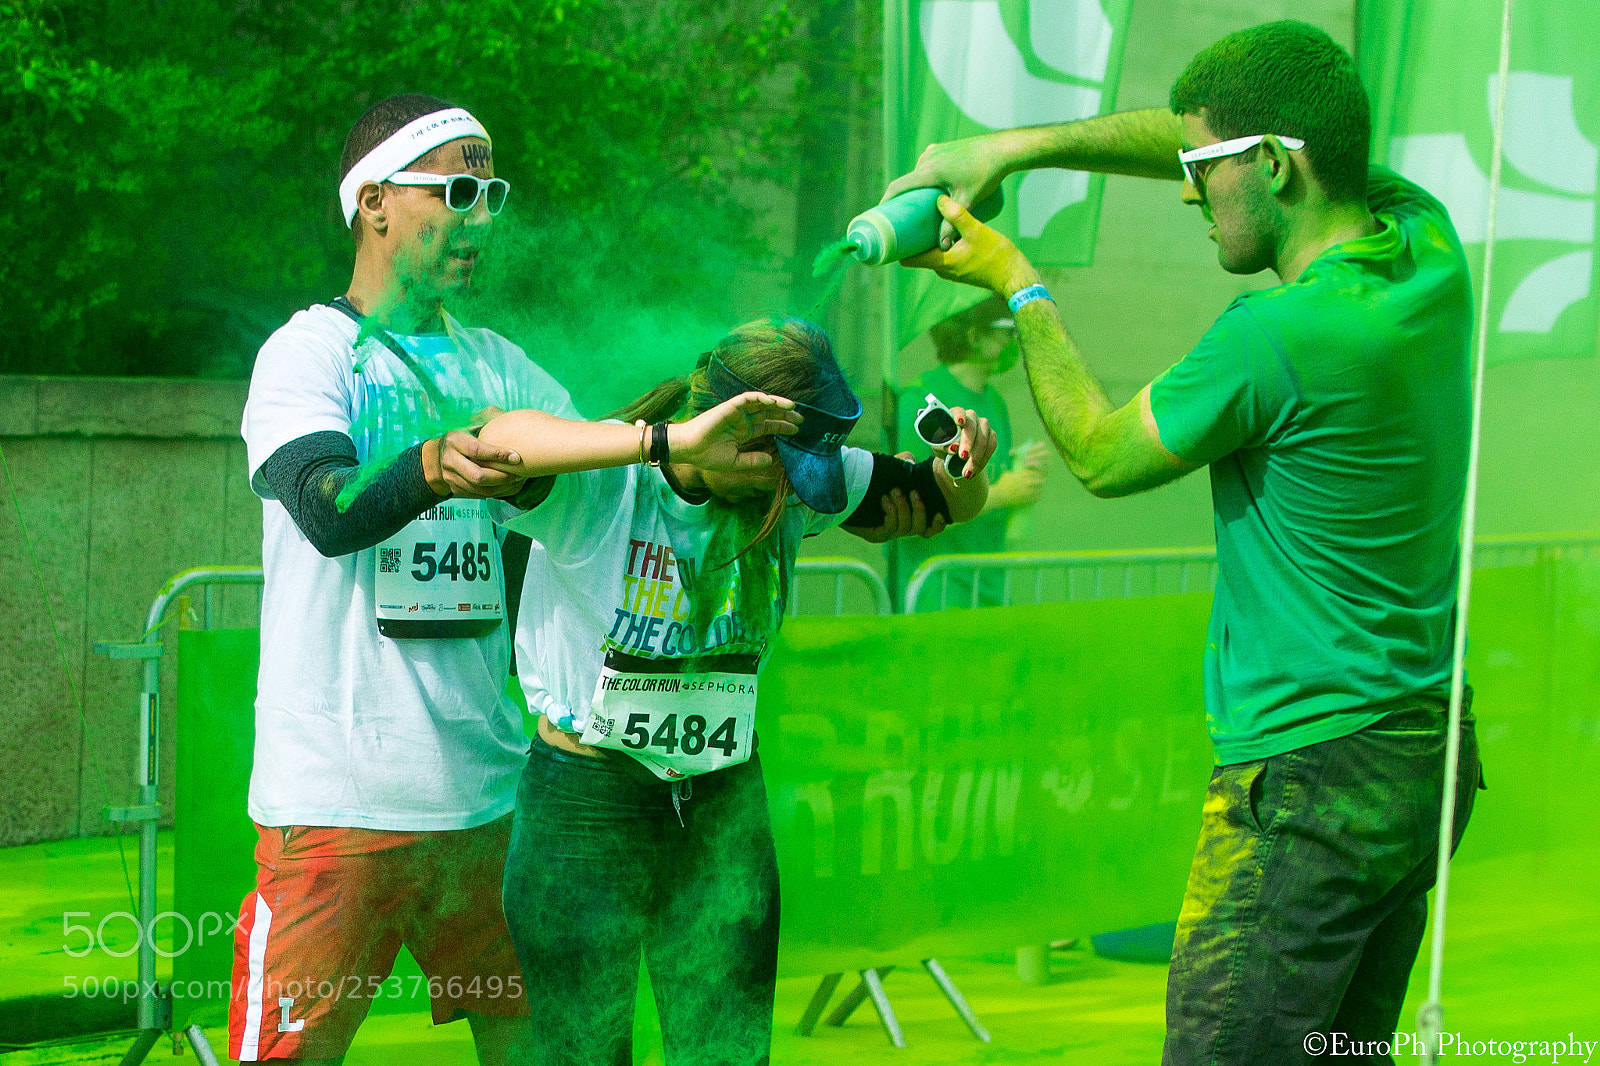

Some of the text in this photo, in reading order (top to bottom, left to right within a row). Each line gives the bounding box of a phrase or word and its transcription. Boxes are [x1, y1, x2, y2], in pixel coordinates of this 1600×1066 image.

[411, 541, 491, 582] 5485
[627, 538, 677, 582] THE
[623, 574, 673, 618] THE
[608, 607, 664, 652] THE
[601, 676, 622, 691] THE
[621, 678, 658, 692] COLOR
[690, 681, 755, 695] SEPHORA
[620, 713, 738, 757] 5484
[278, 998, 304, 1032] L
